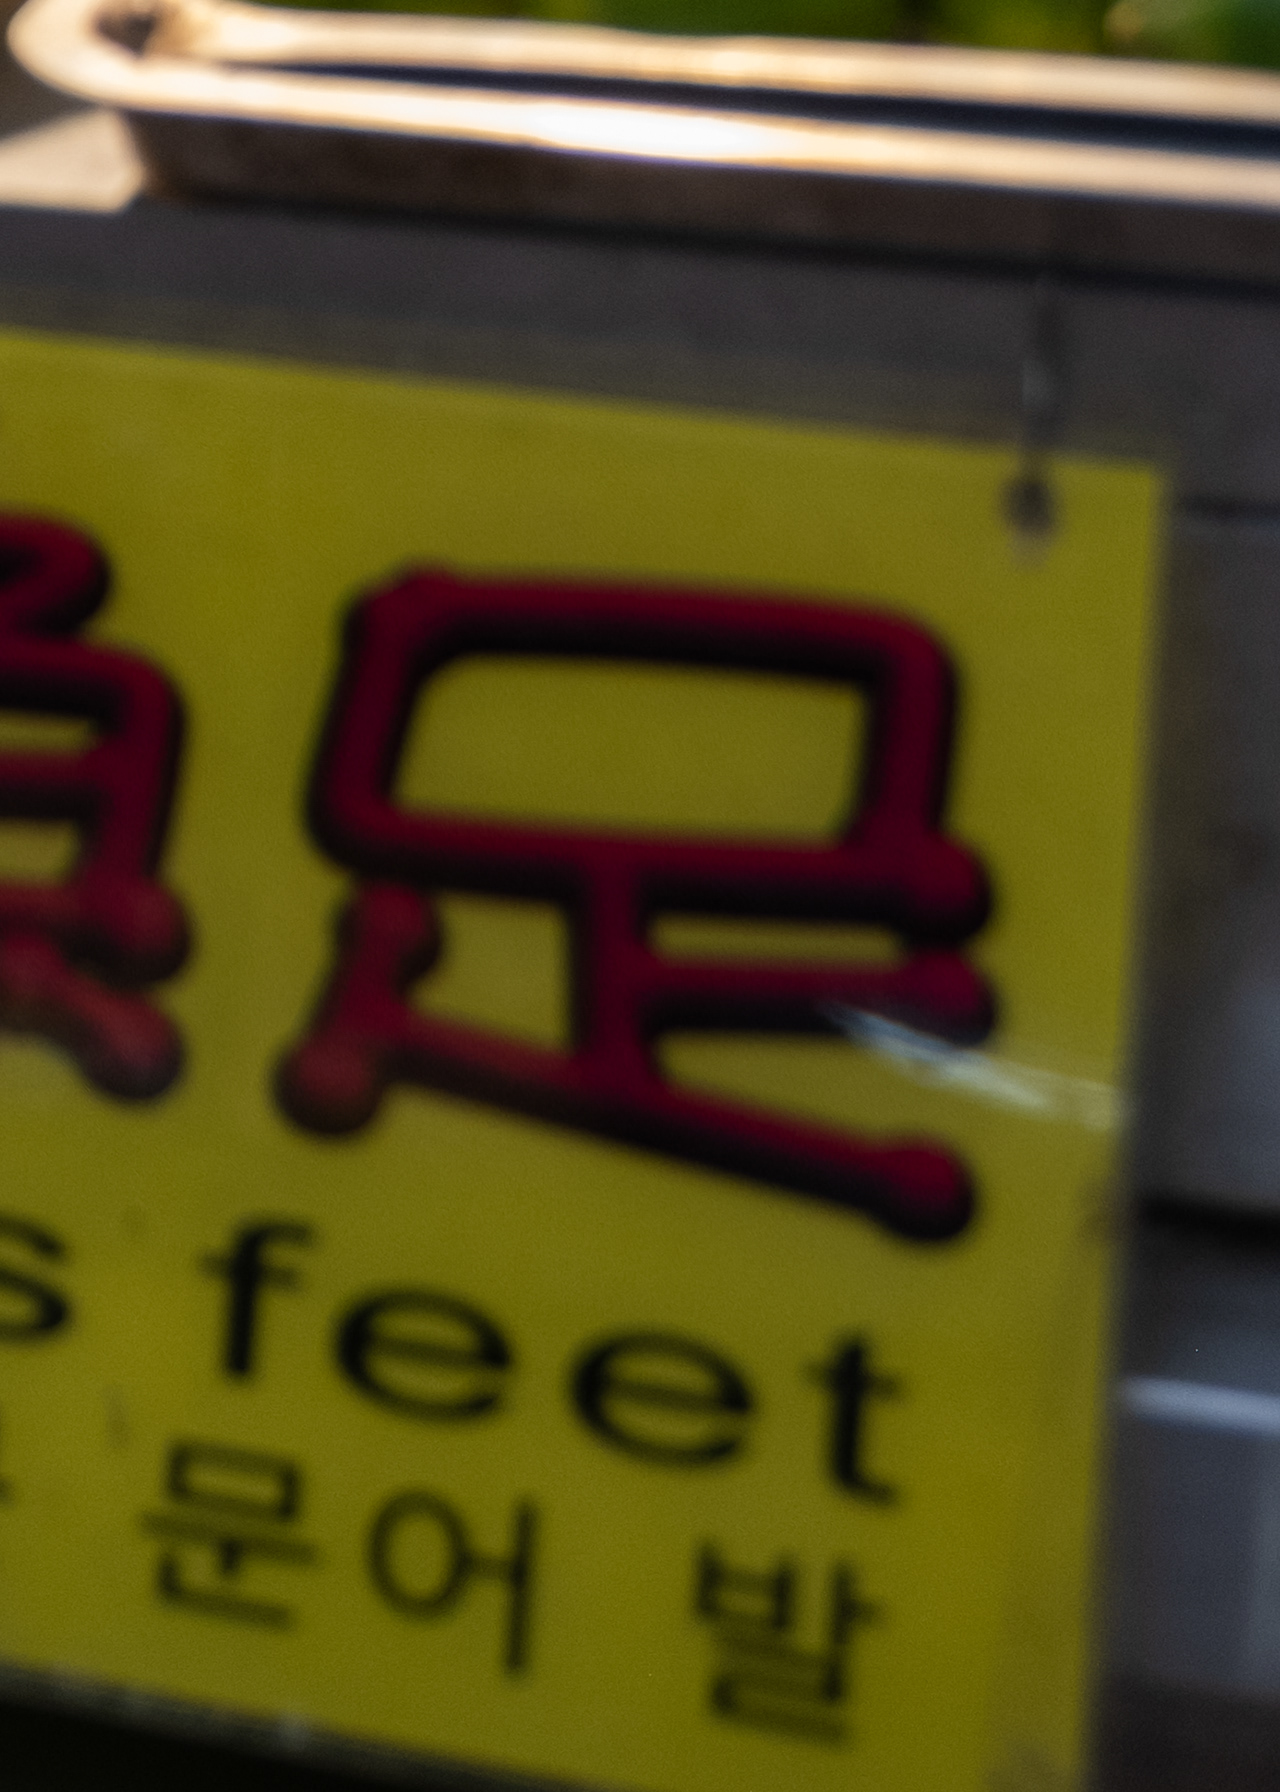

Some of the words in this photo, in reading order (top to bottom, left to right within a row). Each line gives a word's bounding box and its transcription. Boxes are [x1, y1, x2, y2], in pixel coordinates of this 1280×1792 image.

[198, 1216, 907, 1509] feet
[138, 1434, 541, 1682] 문어
[688, 1536, 884, 1748] 발
